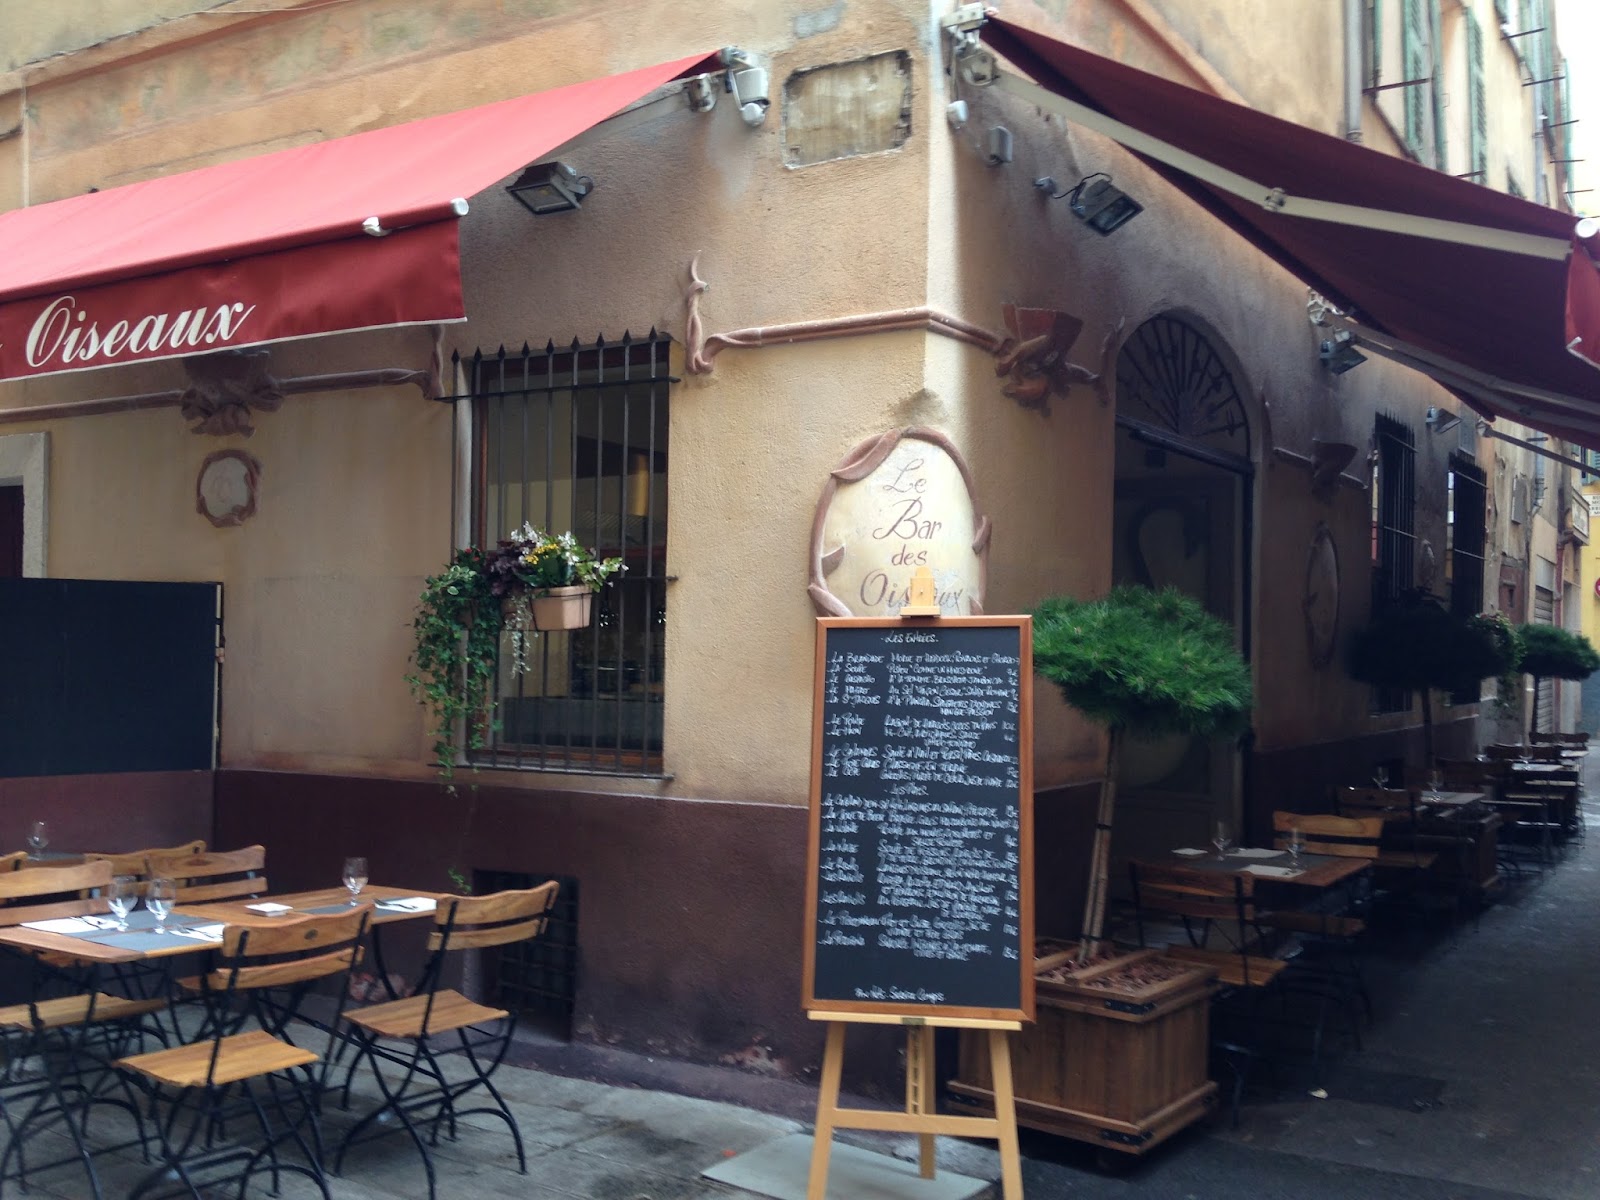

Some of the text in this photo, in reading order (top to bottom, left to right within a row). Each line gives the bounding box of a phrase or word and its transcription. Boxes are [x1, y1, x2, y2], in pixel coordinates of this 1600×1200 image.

[26, 295, 256, 367] Oiseaux
[883, 458, 927, 493] Le
[873, 496, 942, 540] Bar
[891, 544, 927, 566] des
[860, 569, 964, 609] Oisux
